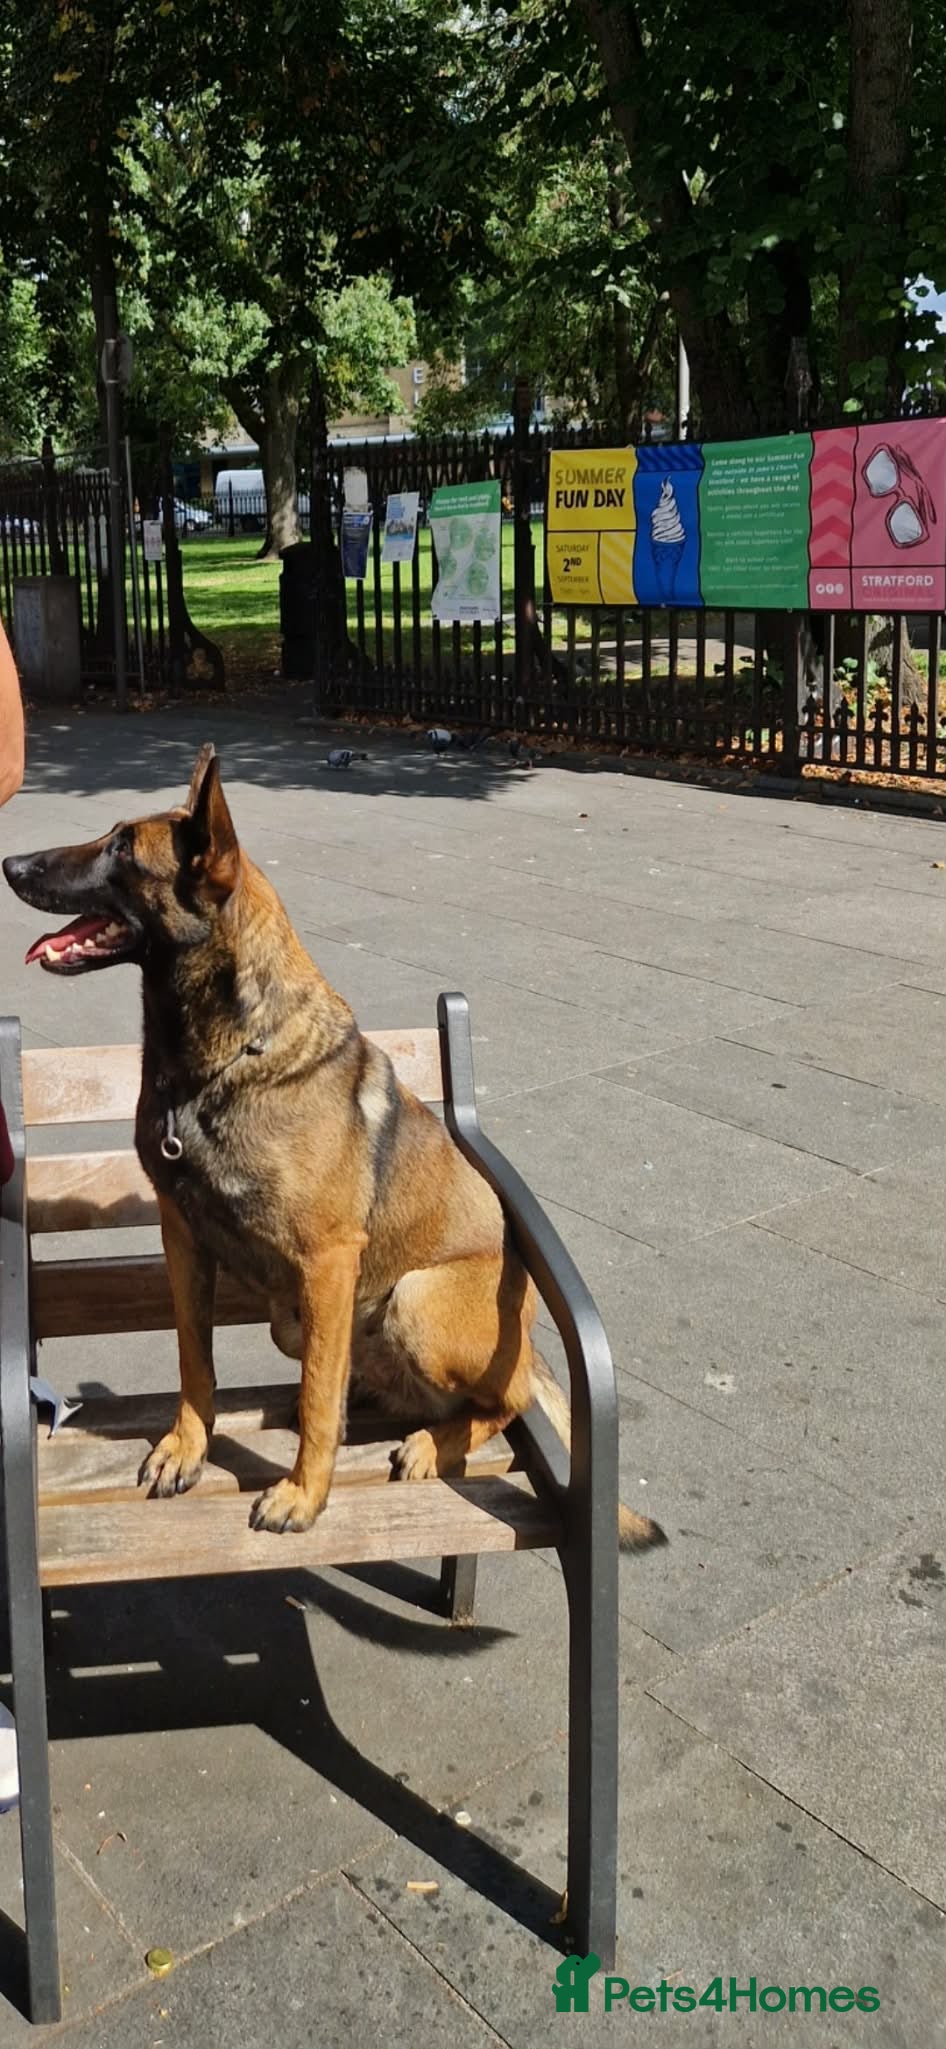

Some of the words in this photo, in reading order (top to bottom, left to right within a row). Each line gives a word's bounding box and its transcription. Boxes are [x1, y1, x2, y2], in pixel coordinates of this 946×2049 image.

[555, 467, 627, 485] SUMMER
[555, 490, 589, 509] FUN
[594, 488, 626, 507] DAY
[555, 543, 590, 554] SATURDAY
[563, 557, 582, 573] 2ND
[557, 576, 590, 584] SEPTEMBER
[862, 575, 934, 587] STRATFORD
